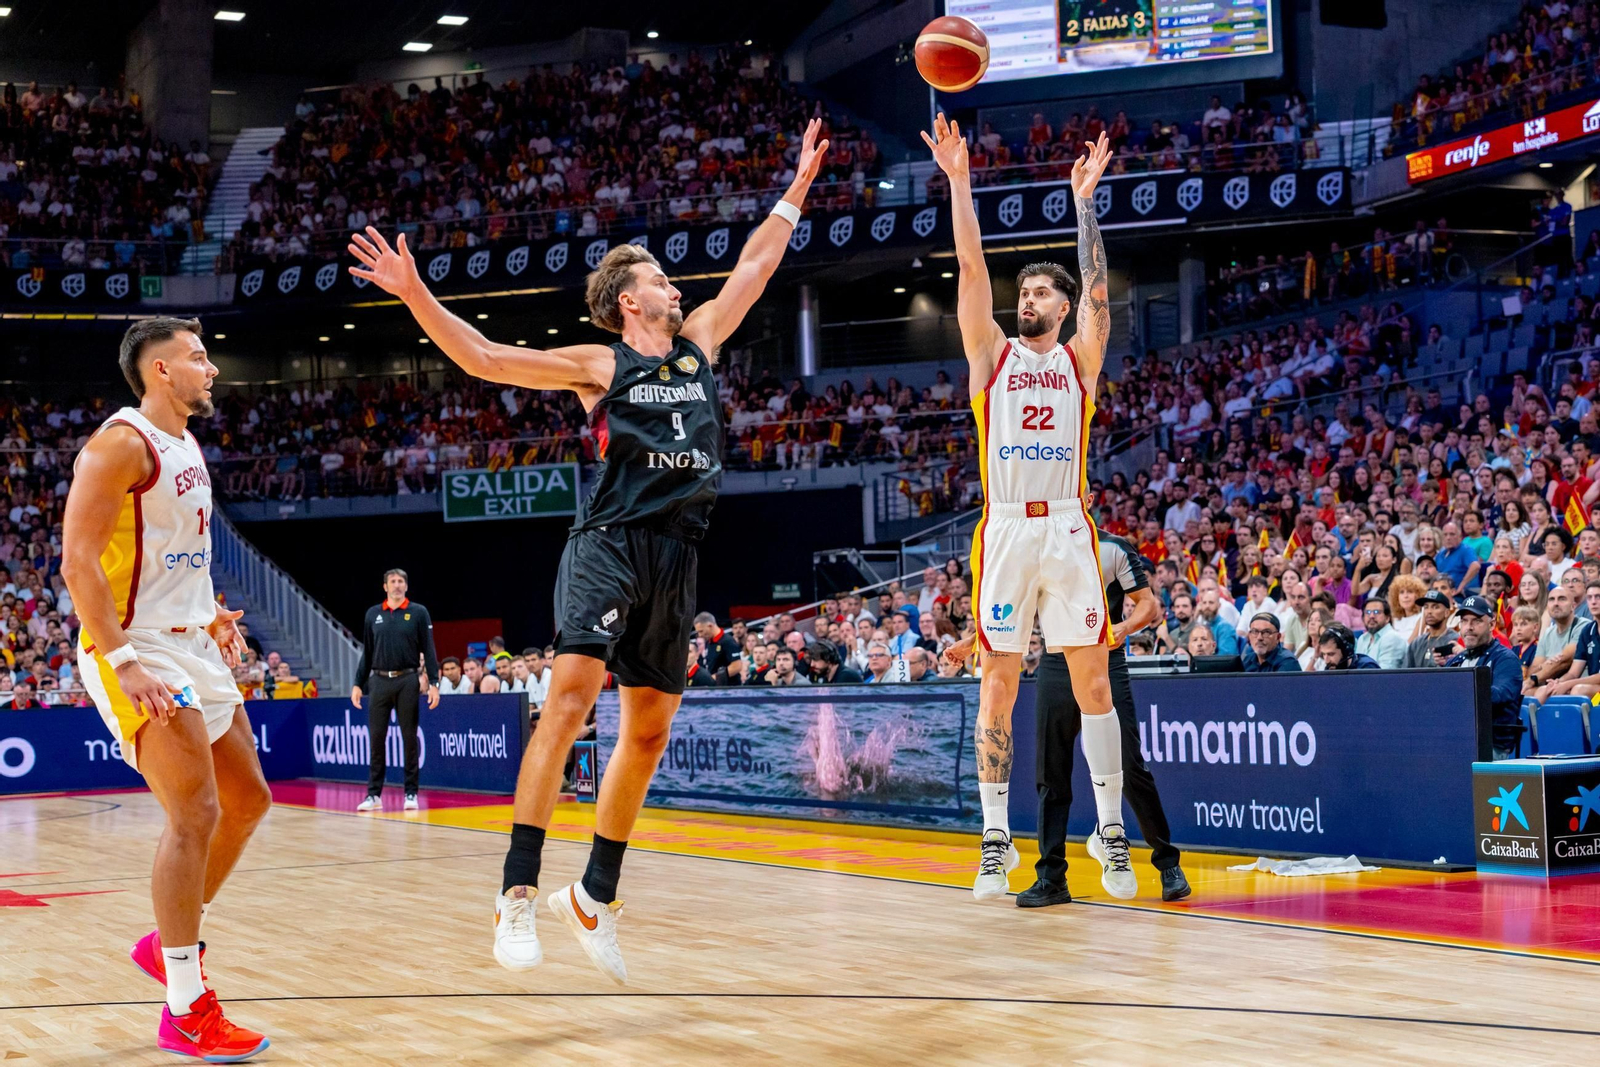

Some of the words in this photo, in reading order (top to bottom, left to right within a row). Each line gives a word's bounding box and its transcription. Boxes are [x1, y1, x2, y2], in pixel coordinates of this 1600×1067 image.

[1066, 19, 1079, 37] 2
[1083, 14, 1129, 33] FALTAS
[1133, 11, 1146, 29] 3
[1444, 134, 1490, 167] renfe
[628, 382, 708, 404] DEUTSCHLAND
[1006, 368, 1071, 395] ESPAÑA
[671, 412, 687, 441] 9
[1021, 405, 1056, 431] 22
[646, 451, 691, 470] ING
[451, 469, 569, 499] SALIDA
[484, 495, 537, 516] EXIT
[898, 660, 906, 671] 3
[899, 671, 907, 682] 2
[439, 732, 467, 758] new
[468, 723, 508, 759] travel
[1193, 800, 1245, 829] new
[1249, 796, 1325, 834] travel
[1480, 837, 1540, 860] CaixaBank
[1553, 836, 1600, 859] CaixaB
